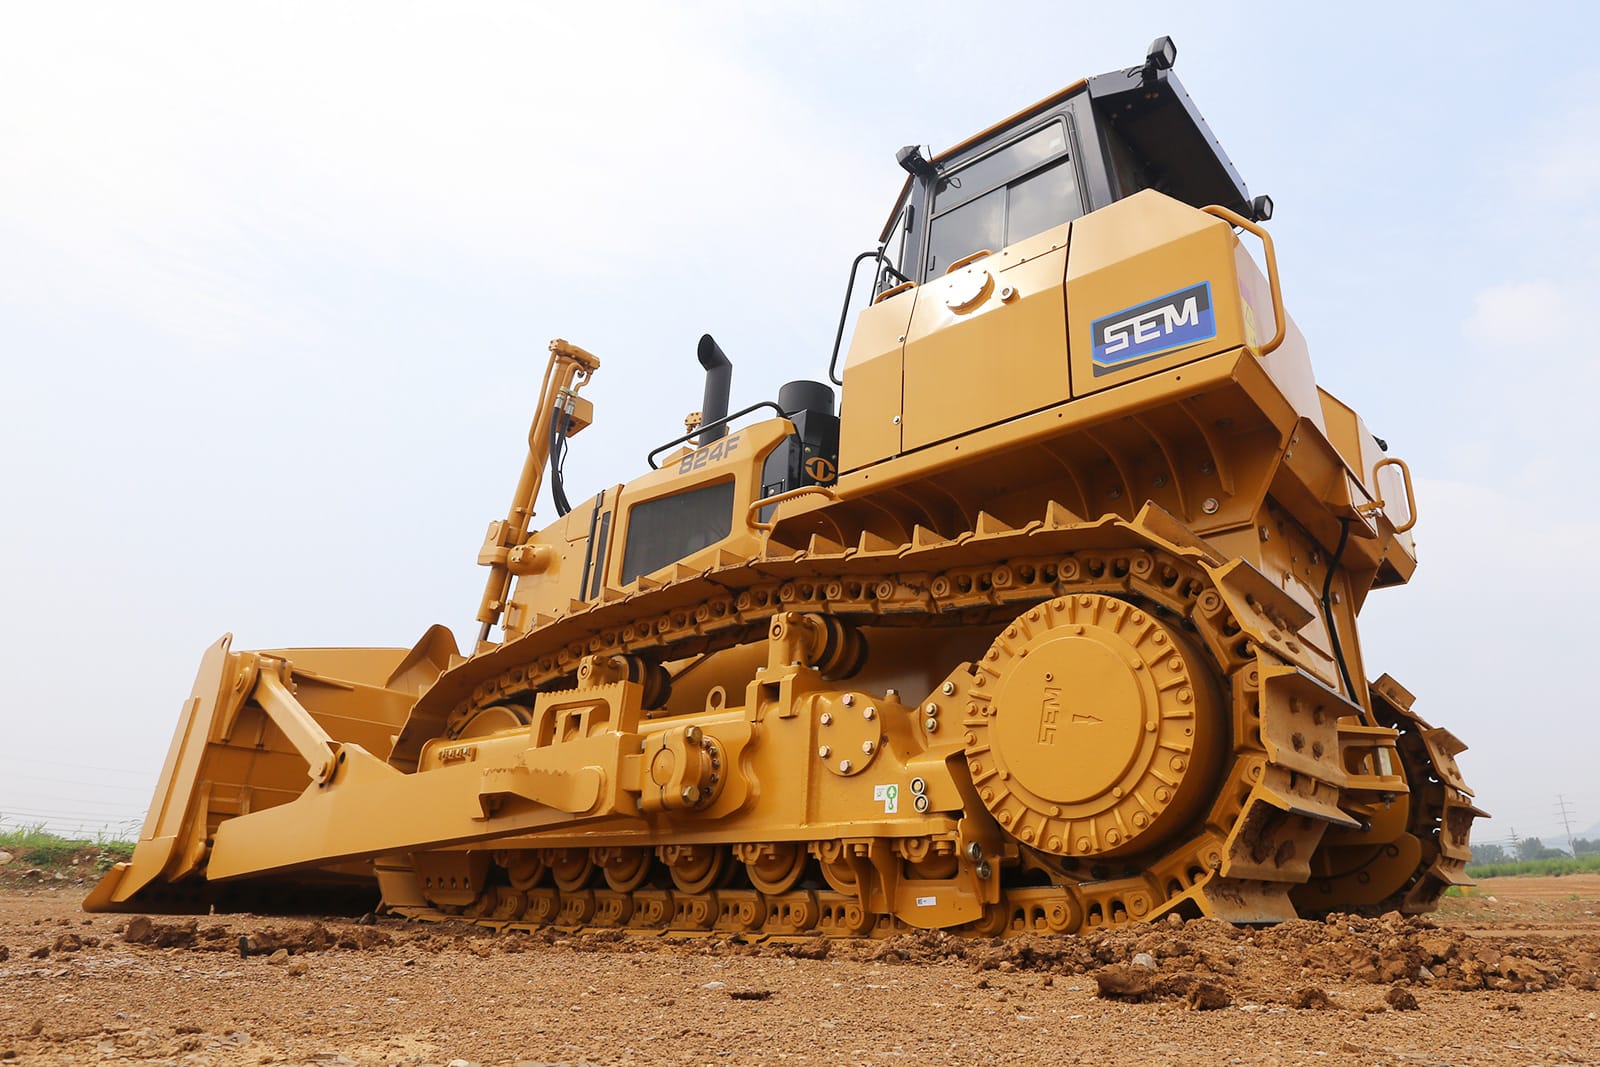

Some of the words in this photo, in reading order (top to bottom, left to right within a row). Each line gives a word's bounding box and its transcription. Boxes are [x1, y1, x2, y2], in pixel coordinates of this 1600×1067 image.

[1103, 296, 1199, 355] SEM
[679, 436, 740, 475] 824F
[1037, 687, 1062, 745] SEM
